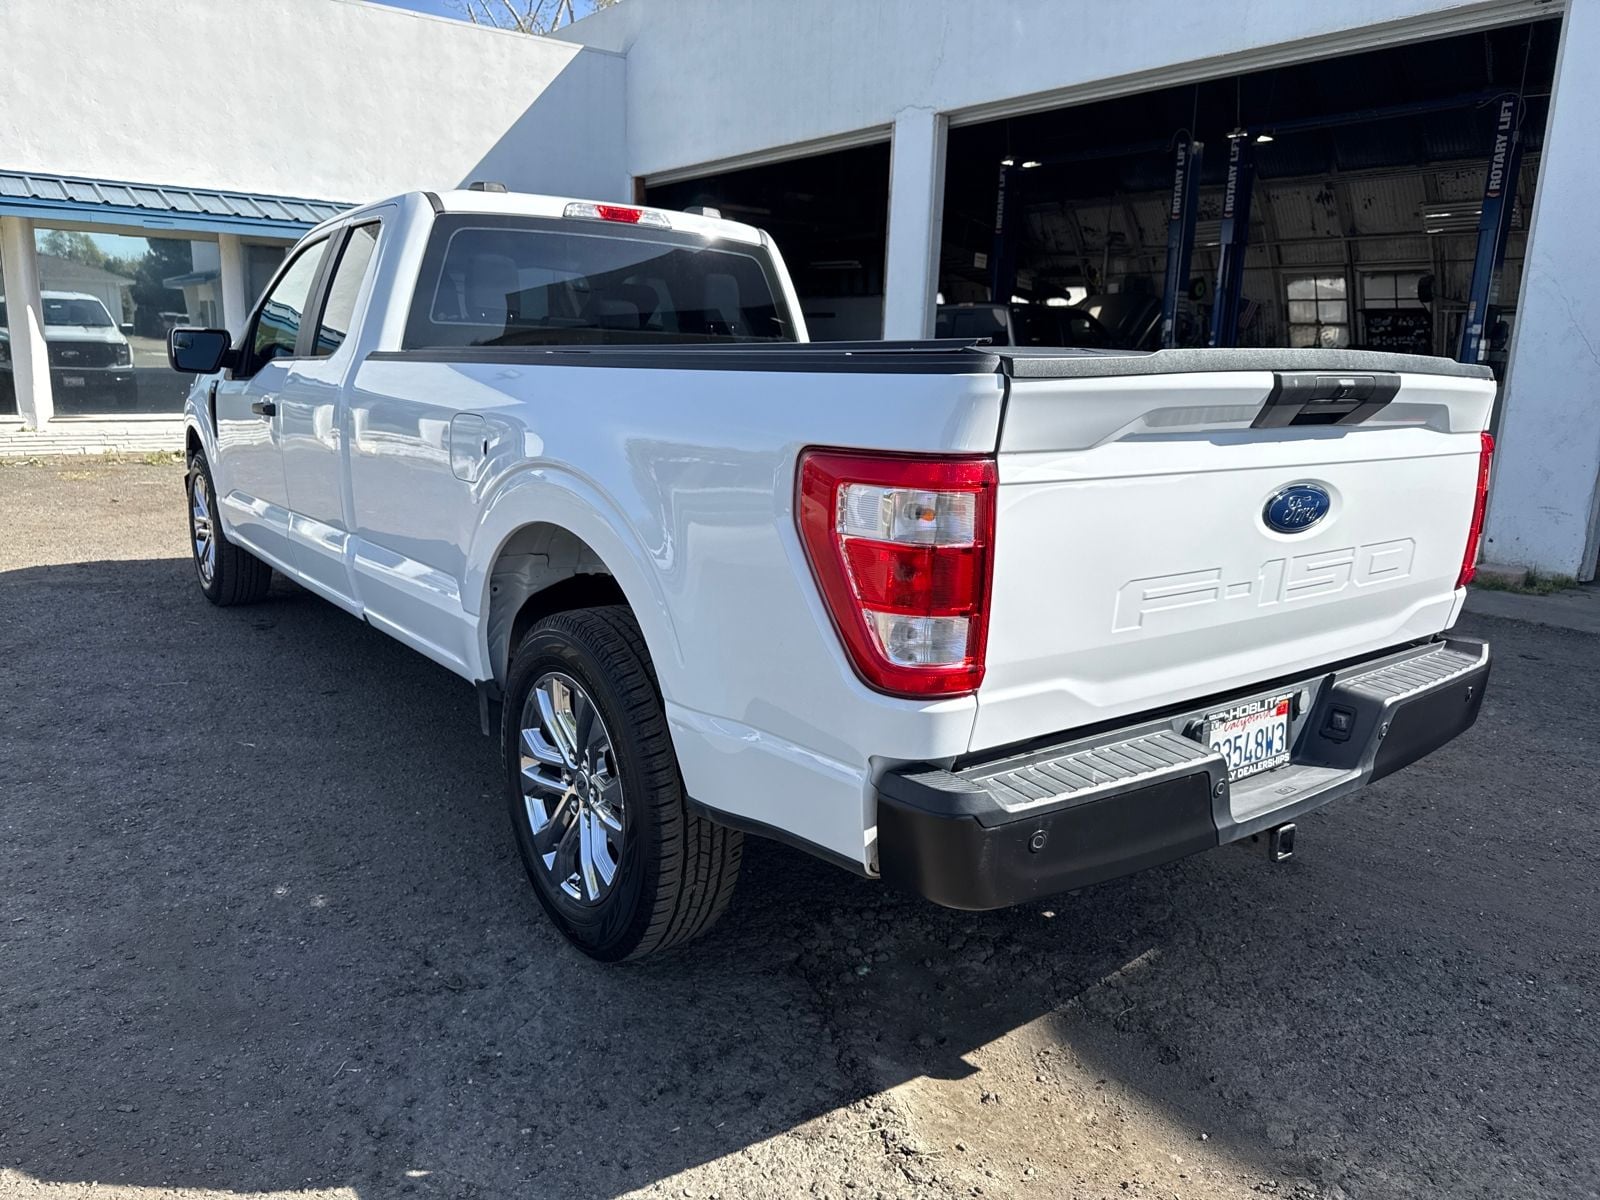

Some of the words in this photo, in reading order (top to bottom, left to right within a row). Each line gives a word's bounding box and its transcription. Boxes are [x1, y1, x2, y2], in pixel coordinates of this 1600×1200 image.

[1498, 100, 1513, 131] LIFT
[1176, 142, 1187, 166] LIFT
[1229, 137, 1241, 162] LIFT
[1489, 133, 1508, 191] ROTARY
[1172, 169, 1184, 213] ROTARY
[1225, 164, 1238, 212] ROTARY
[1282, 494, 1320, 525] Ford
[1112, 537, 1416, 633] F-150
[1230, 699, 1275, 720] HOBLIT
[1237, 752, 1290, 778] DEALERSHIPS
